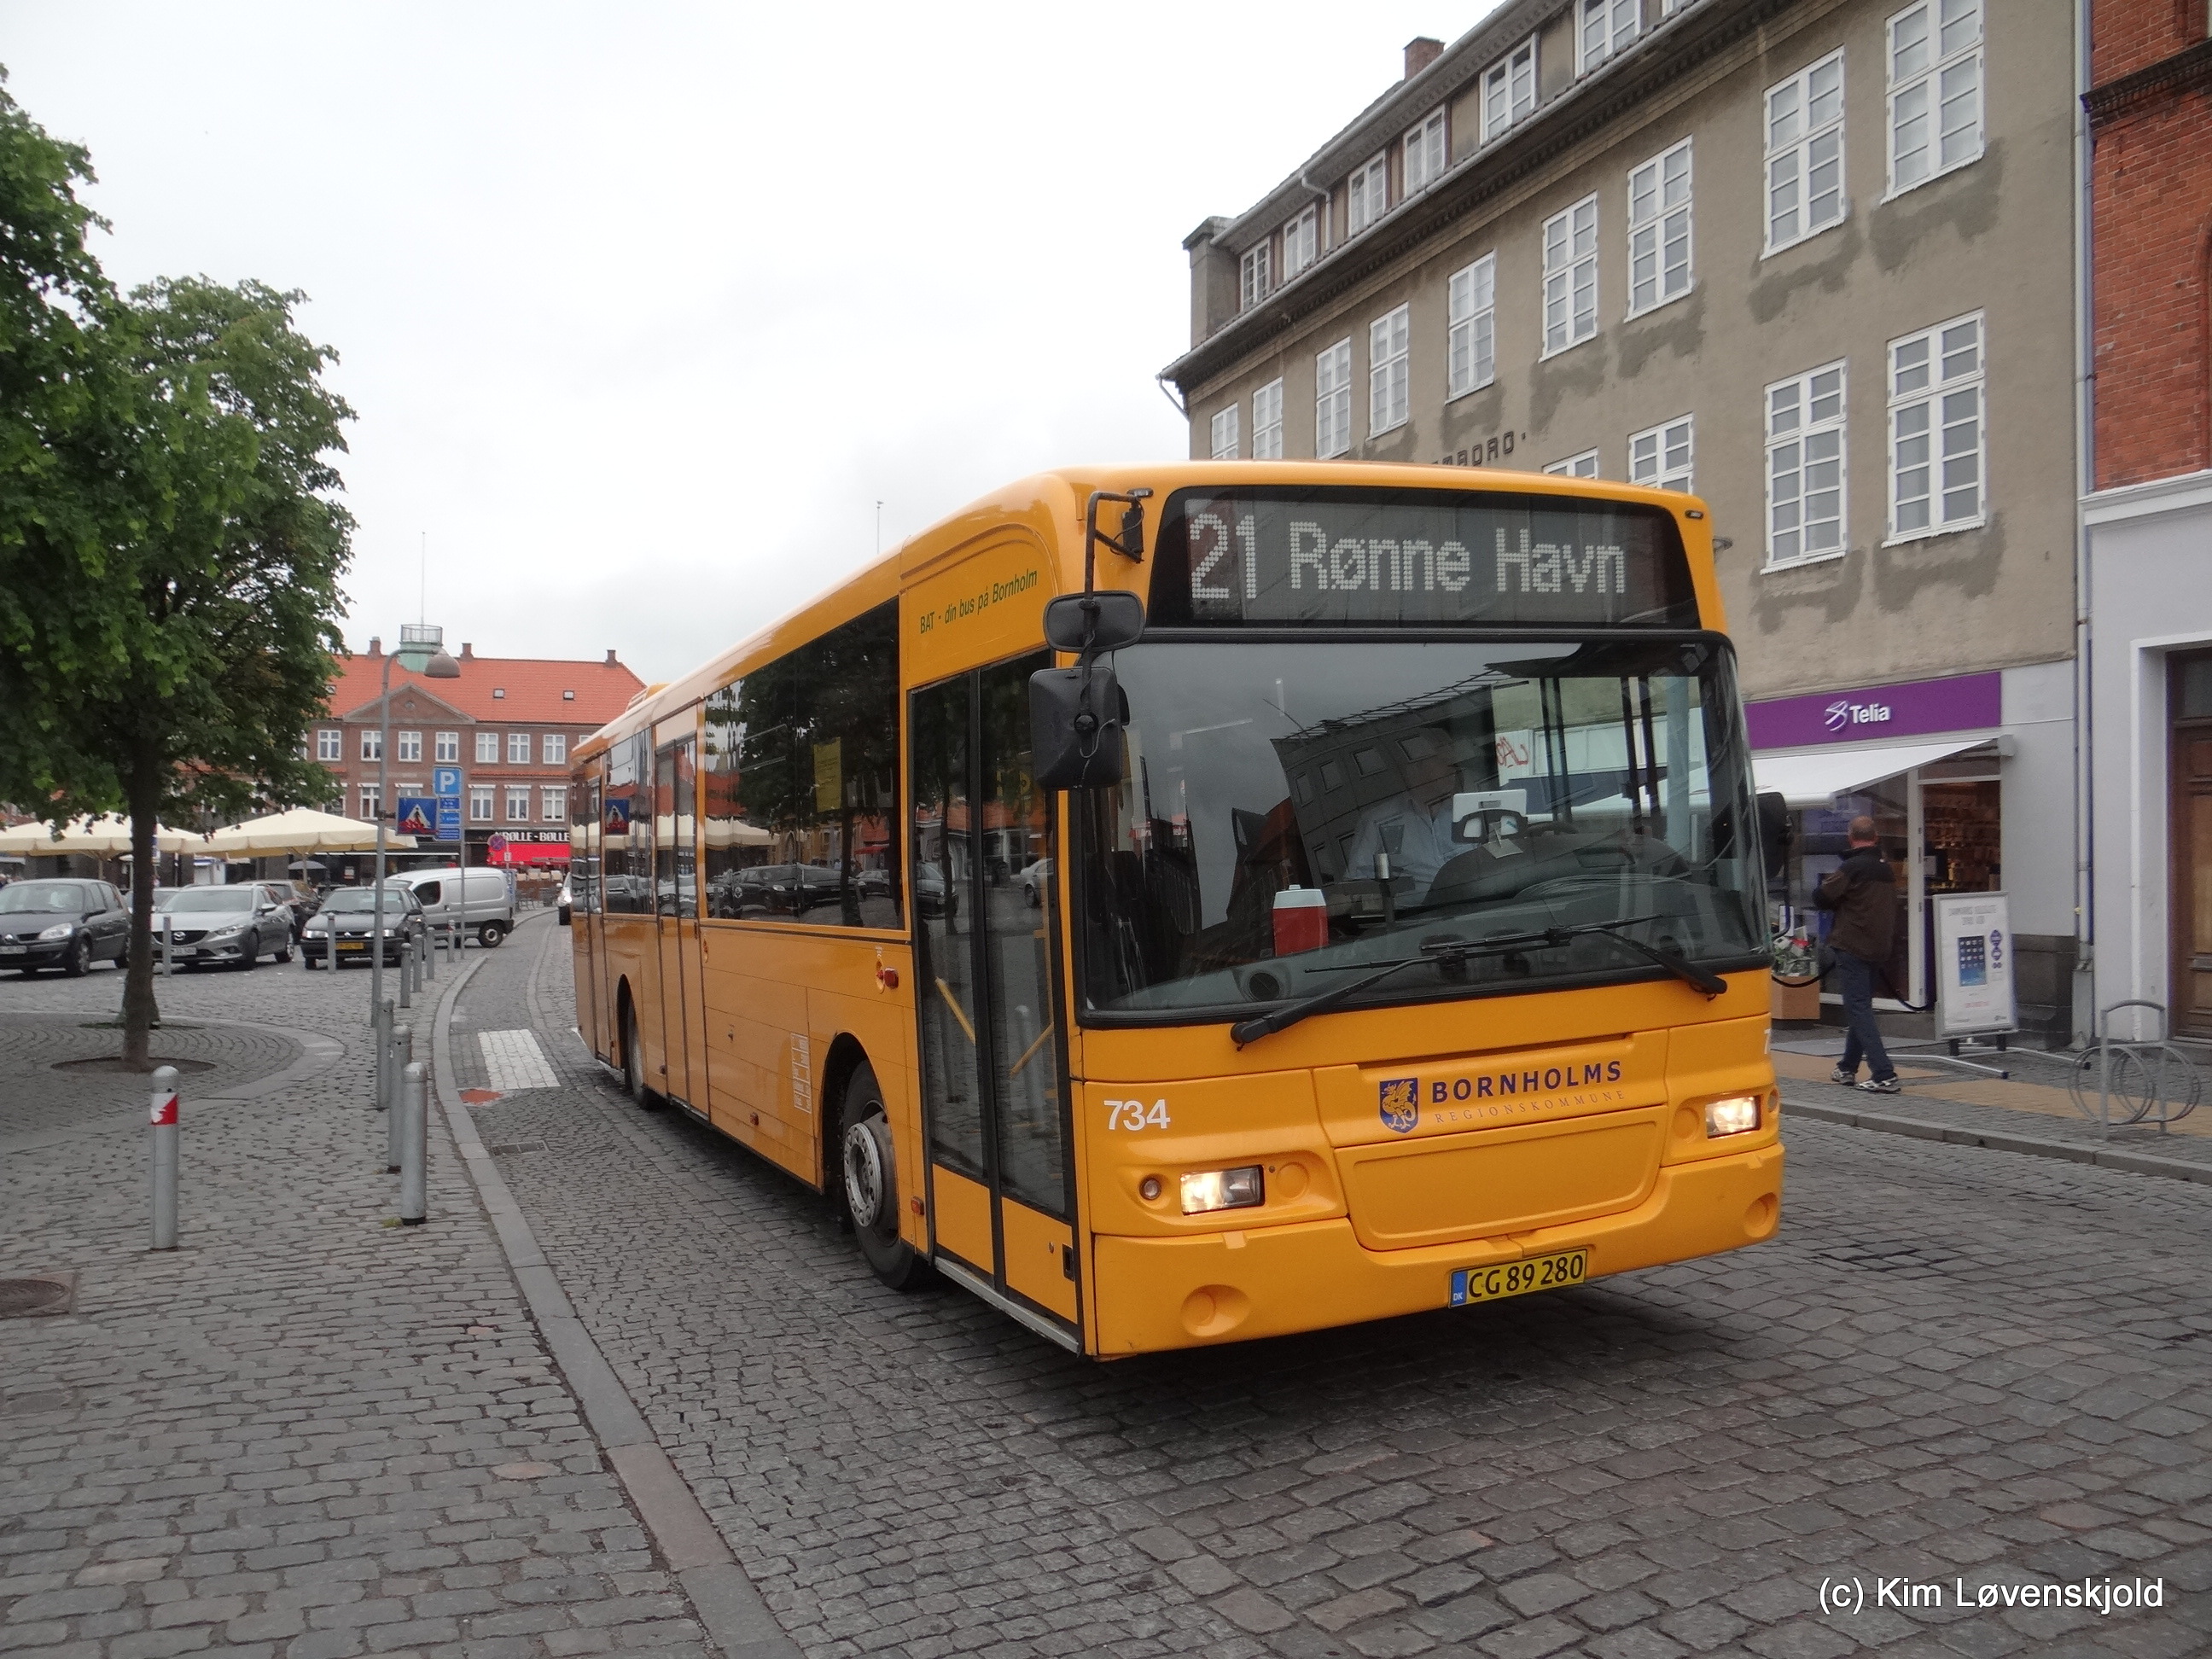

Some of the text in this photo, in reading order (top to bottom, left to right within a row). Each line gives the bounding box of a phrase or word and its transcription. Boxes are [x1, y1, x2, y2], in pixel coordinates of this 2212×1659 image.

[1189, 514, 1625, 599] 21 Rønne Havn
[920, 611, 934, 634] BAT
[945, 602, 957, 624] din
[959, 598, 975, 618] bus
[977, 585, 989, 615] på
[992, 568, 1038, 604] Bornholm
[1848, 703, 1891, 724] Telia
[439, 771, 456, 793] P
[1431, 1060, 1621, 1103] BORNHOLMS
[1103, 1099, 1171, 1131] 734
[1435, 1089, 1625, 1124] REGIONSKOMMUNE
[1469, 1254, 1584, 1298] CG 89 280
[1452, 1292, 1463, 1301] DK
